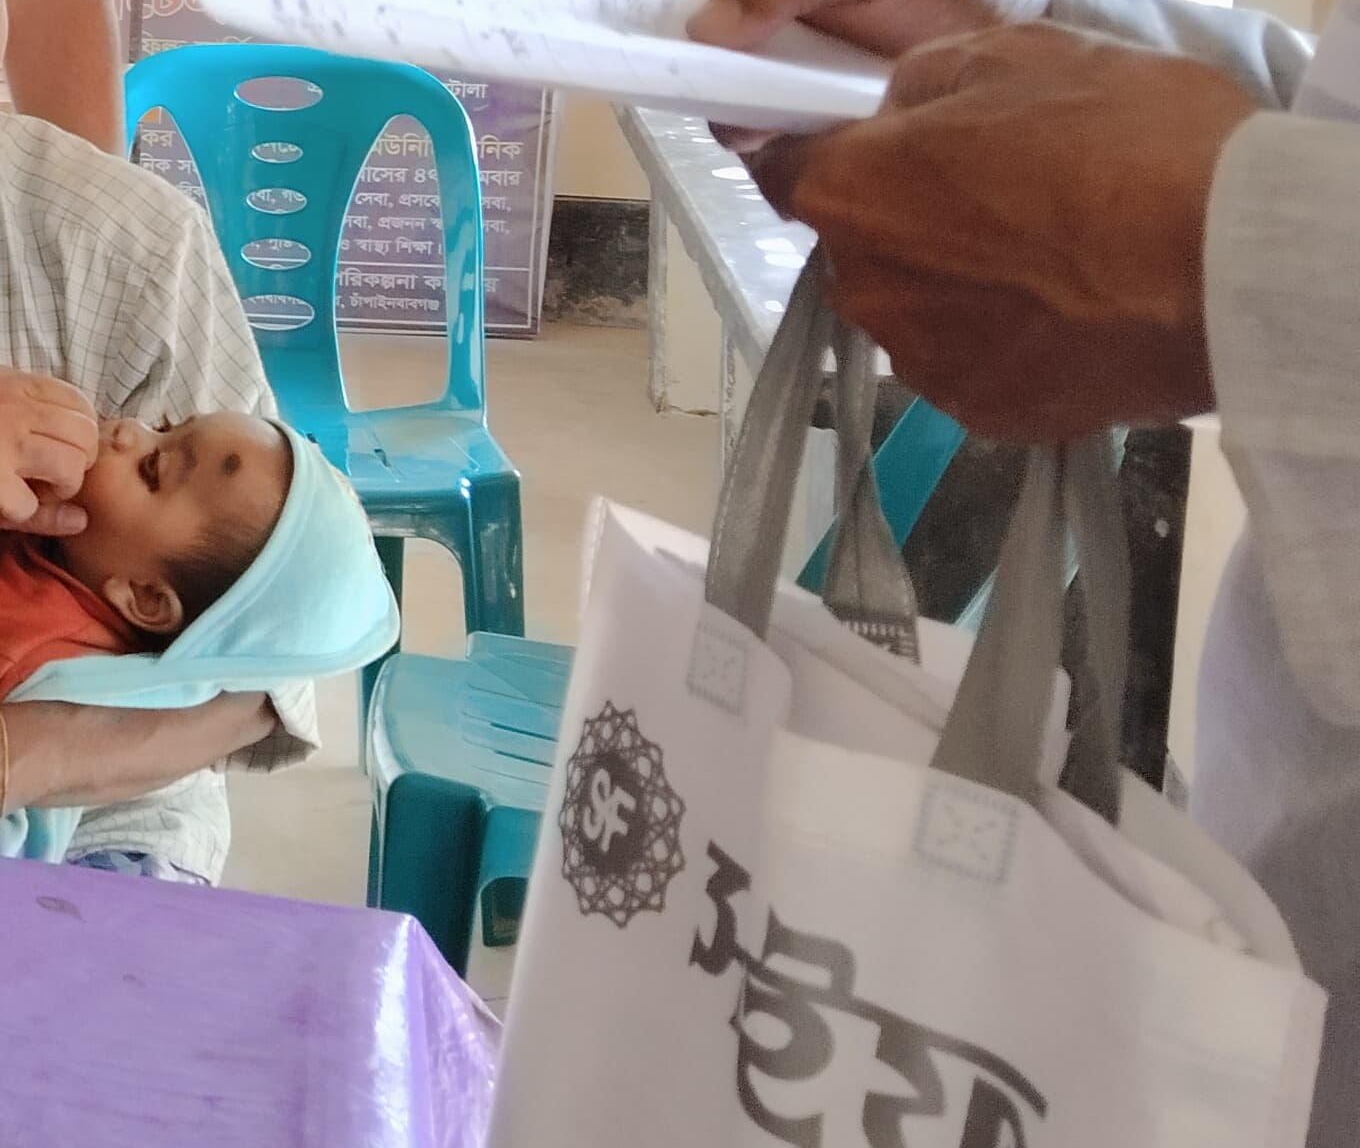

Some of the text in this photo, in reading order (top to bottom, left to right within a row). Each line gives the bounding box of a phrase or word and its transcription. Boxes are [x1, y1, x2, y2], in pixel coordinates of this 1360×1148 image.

[355, 192, 394, 208] সেবা,
[377, 216, 426, 230] প্রজনন
[353, 238, 393, 256] স্বাস্থ্য
[394, 236, 435, 255] শিক্ষা
[349, 292, 440, 311] চাঁপাইনবাবগঞ্জ
